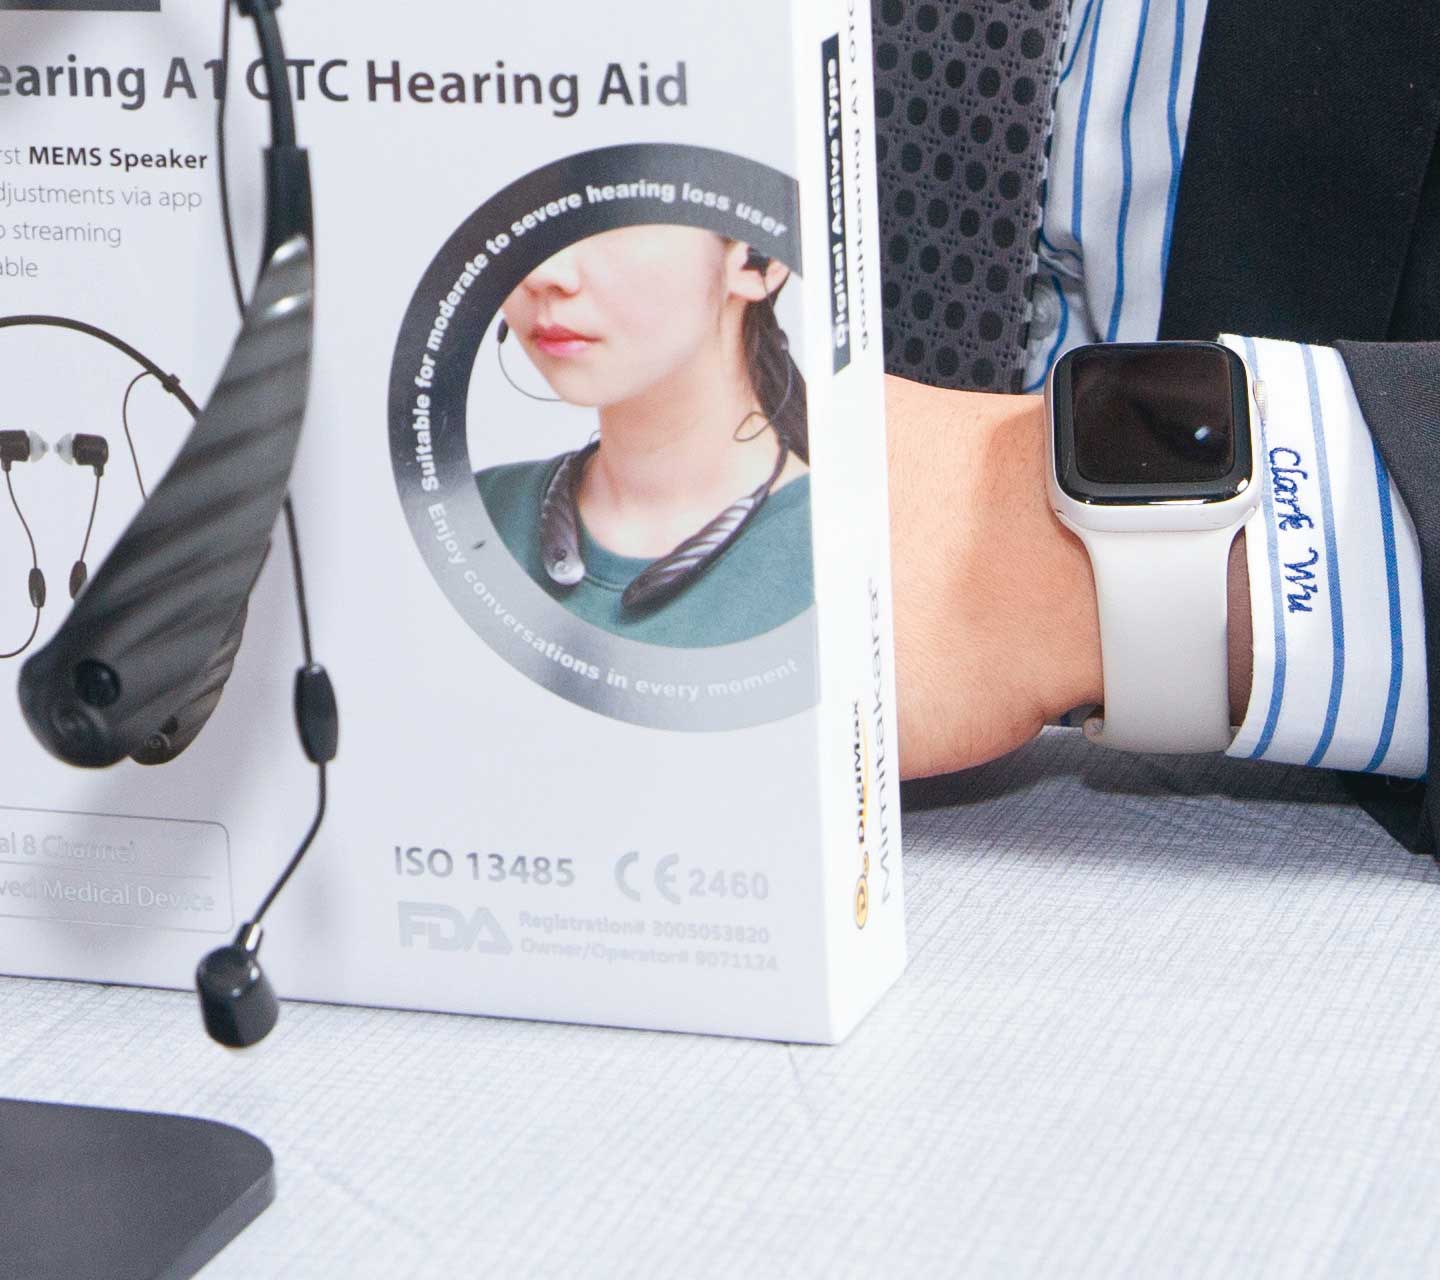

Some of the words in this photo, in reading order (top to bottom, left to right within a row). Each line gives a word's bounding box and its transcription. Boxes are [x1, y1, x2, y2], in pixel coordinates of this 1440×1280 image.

[367, 60, 579, 118] Hearing
[598, 61, 688, 107] Aid
[827, 58, 839, 136] Type
[29, 146, 103, 169] MEMS
[109, 147, 208, 175] Speaker
[121, 187, 152, 208] via
[159, 191, 202, 214] app
[585, 180, 676, 205] hearing
[681, 181, 730, 212] loss
[830, 139, 842, 236] Active
[12, 220, 121, 249] streaming
[510, 191, 583, 238] severe
[735, 201, 788, 239] user
[487, 233, 510, 256] to
[428, 254, 489, 351] moderate
[415, 354, 435, 391] for
[412, 393, 440, 492] Suitable
[1269, 447, 1314, 532] Clark
[427, 502, 468, 567] Enjoy
[463, 569, 601, 680] conversations
[605, 667, 629, 689] in
[634, 677, 700, 703] every
[707, 658, 801, 697] moment
[1283, 547, 1319, 615] Wu
[42, 879, 130, 906] Medical
[394, 846, 454, 878] ISO
[466, 851, 576, 888] 13485
[687, 867, 770, 901] 2460
[397, 899, 512, 955] FDA
